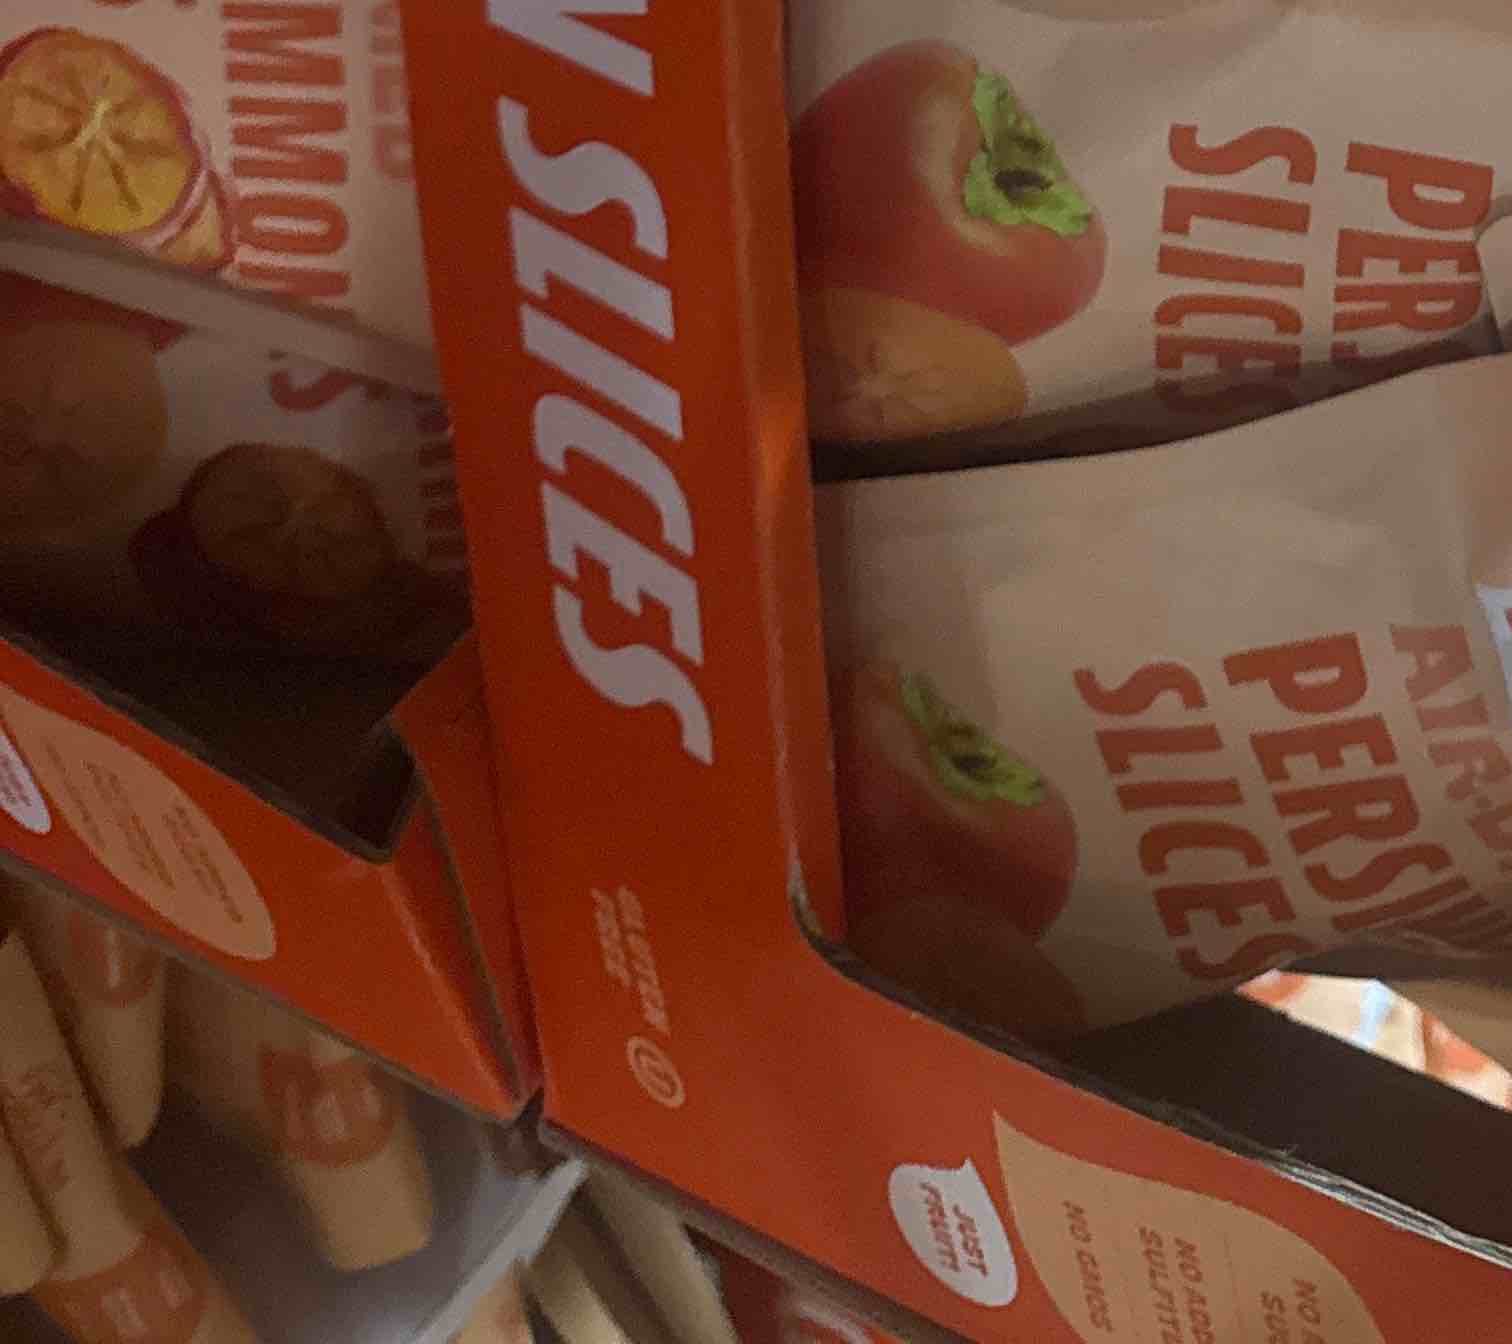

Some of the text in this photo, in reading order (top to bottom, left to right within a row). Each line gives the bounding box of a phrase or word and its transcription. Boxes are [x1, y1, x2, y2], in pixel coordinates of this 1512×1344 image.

[497, 95, 714, 766] SLICES
[1071, 661, 1319, 982] SLICES
[952, 1205, 989, 1278] JUST
[1062, 1200, 1093, 1241] NO
[1173, 1237, 1204, 1282] NO
